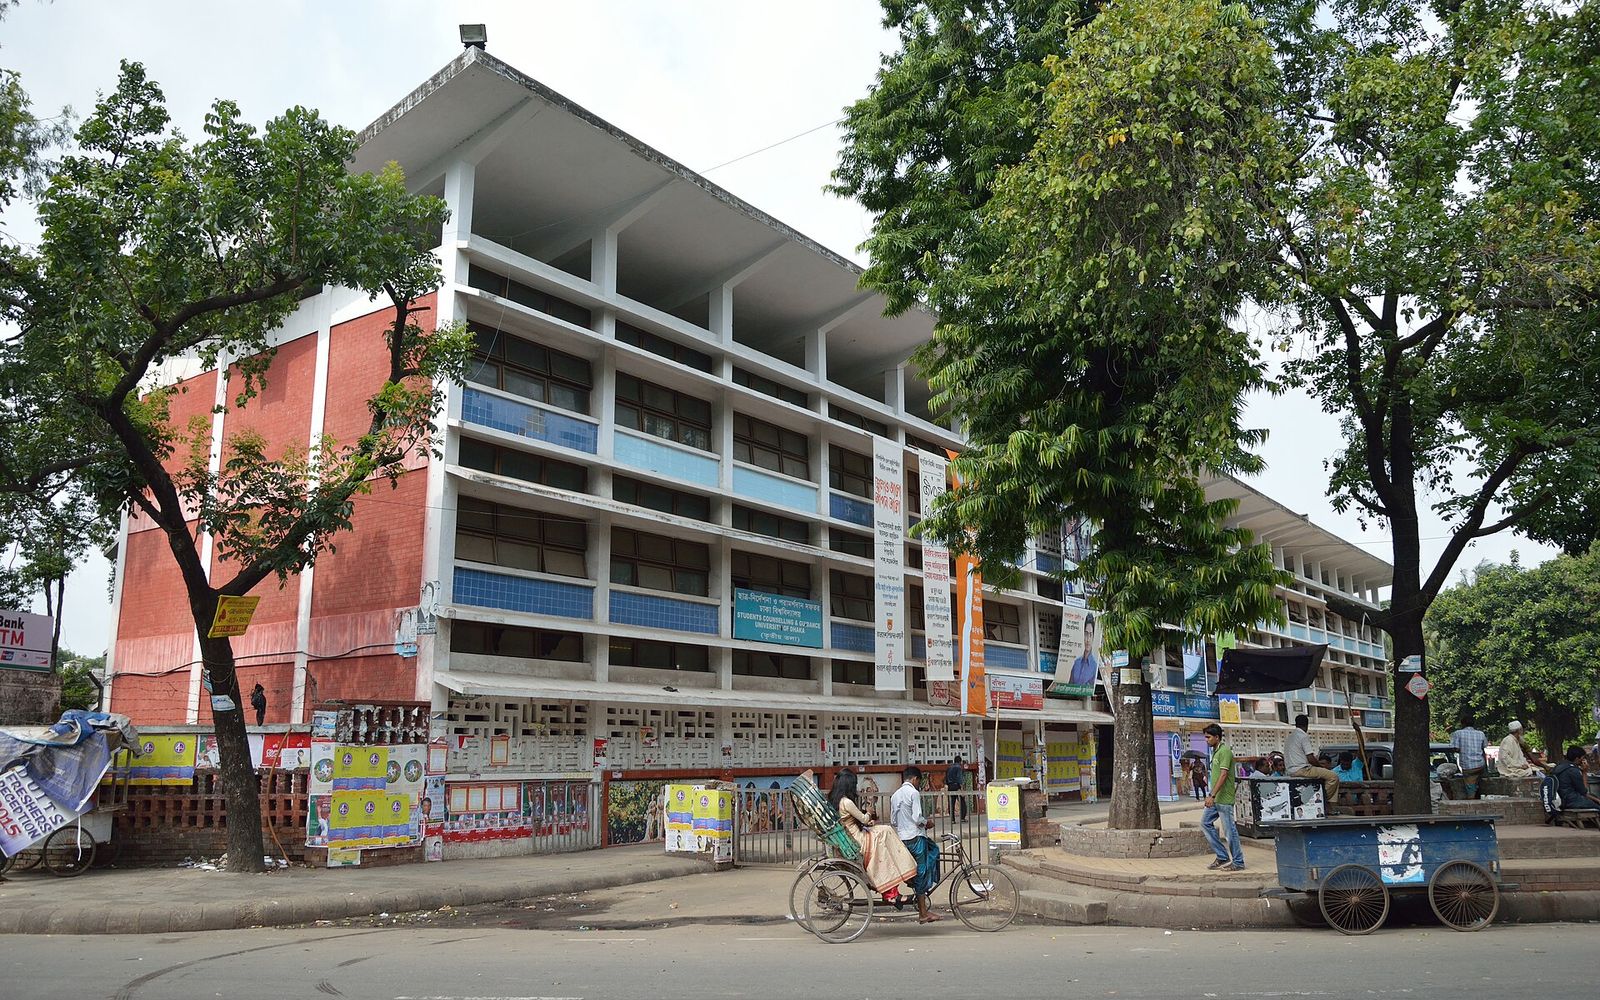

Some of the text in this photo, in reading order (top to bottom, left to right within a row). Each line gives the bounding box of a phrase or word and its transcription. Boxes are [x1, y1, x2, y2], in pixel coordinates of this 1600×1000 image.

[737, 611, 762, 621] STUDENTS
[763, 615, 794, 626] COUNSELLING
[759, 605, 802, 618] ঢাকা বিশ্ববিদ্যালয়
[0, 615, 24, 630] Bank
[754, 621, 782, 631] UNIVERSITY
[790, 626, 805, 634] DHAKA
[5, 774, 53, 834] FRESHERS
[0, 801, 22, 837] 015
